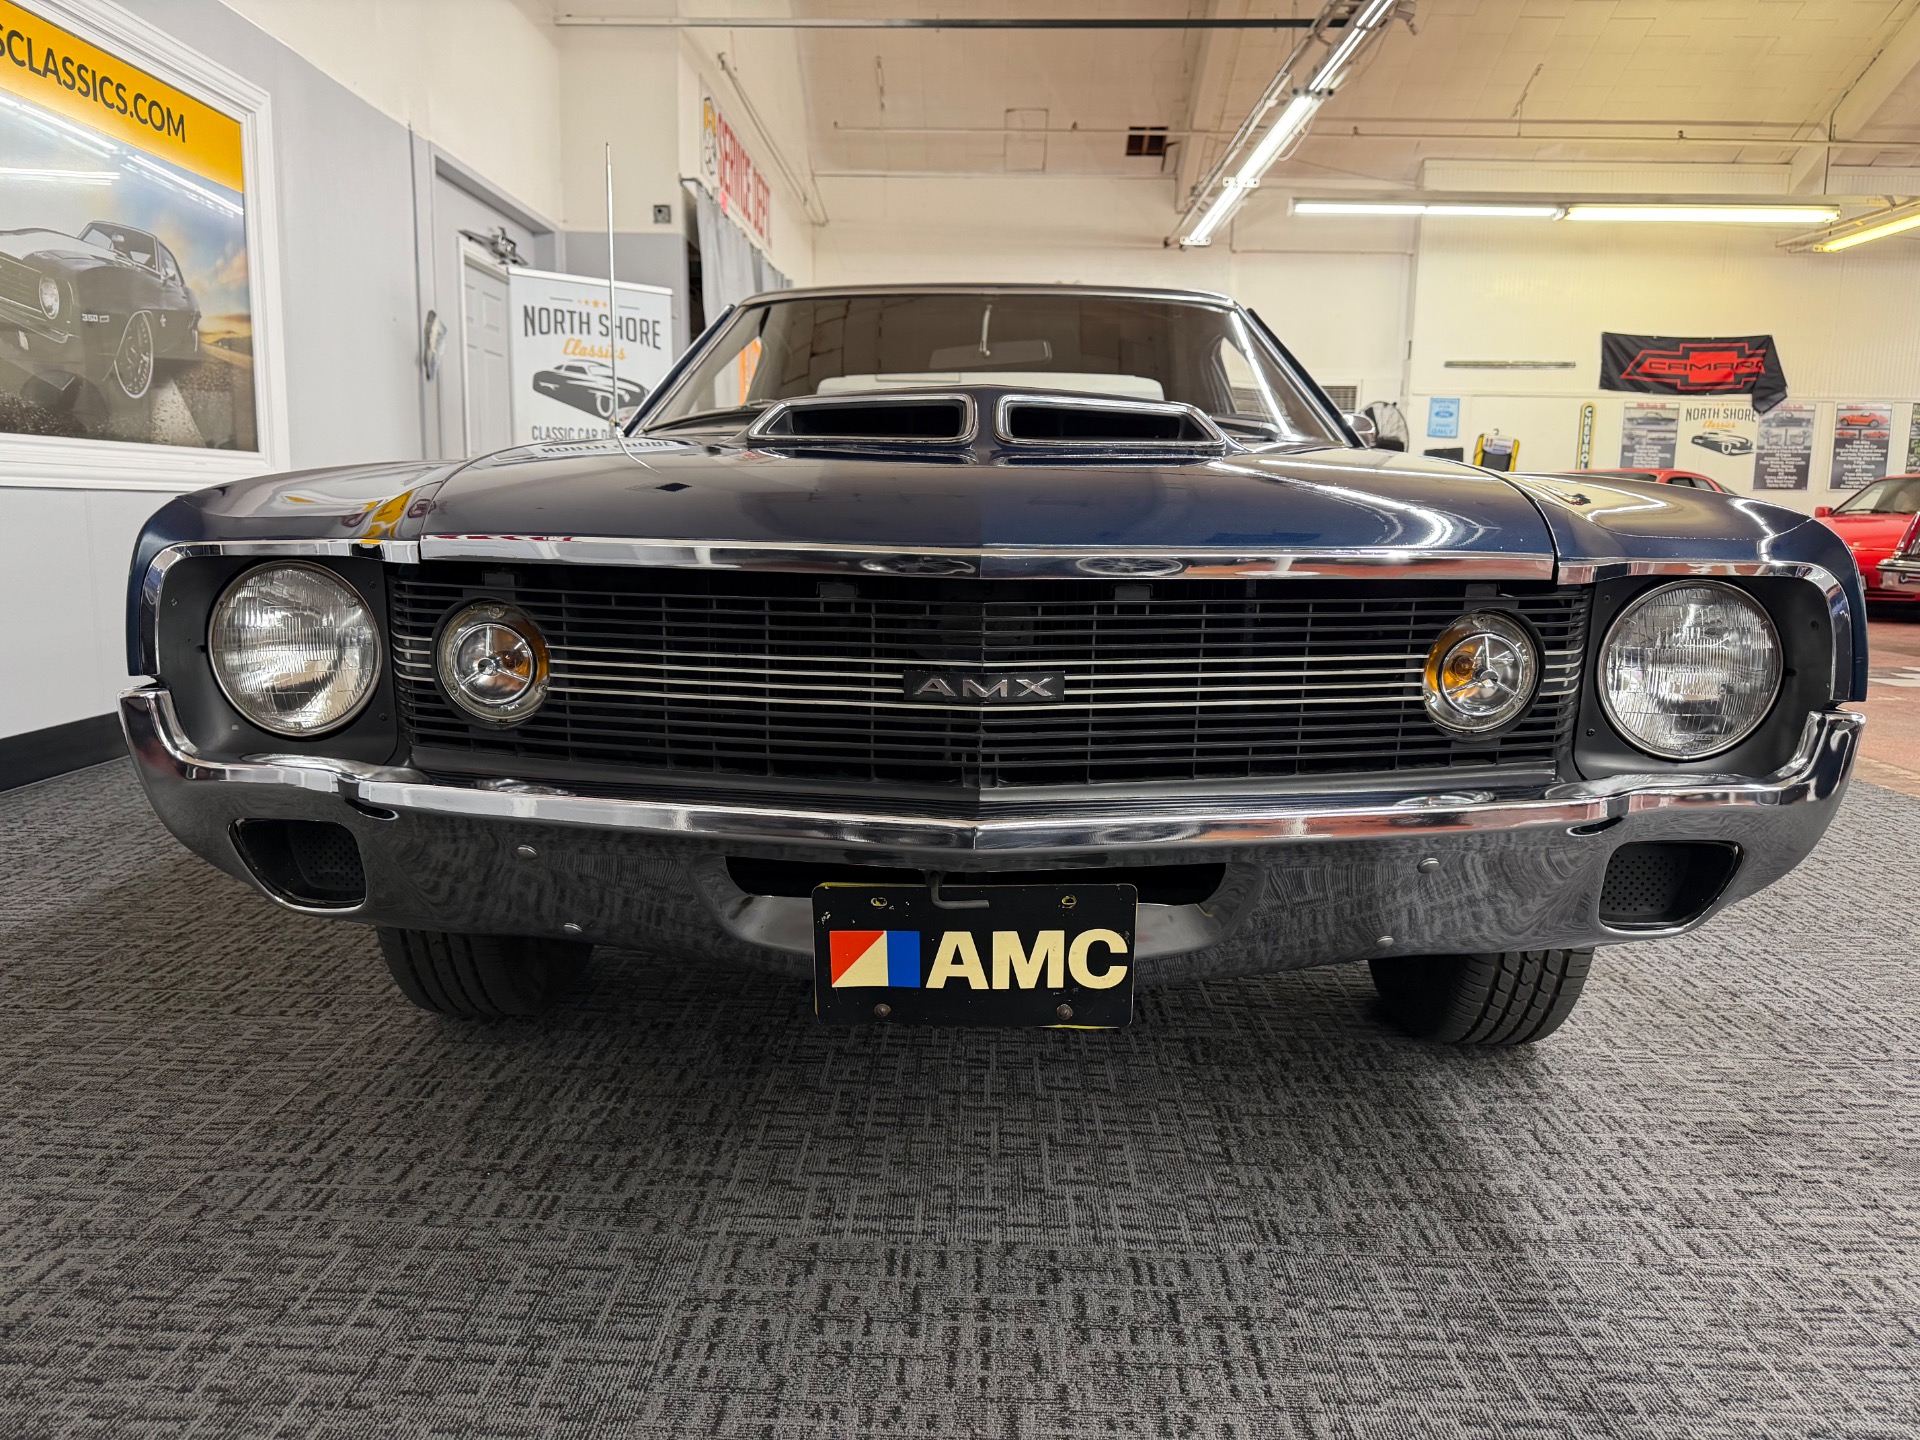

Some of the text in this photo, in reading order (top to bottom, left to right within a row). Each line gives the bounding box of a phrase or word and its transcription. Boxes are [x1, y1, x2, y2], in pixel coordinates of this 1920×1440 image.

[523, 304, 662, 350] NORTH SHORE
[563, 337, 627, 361] Classis
[1685, 407, 1756, 423] NORTH SHORE
[532, 425, 574, 441] CLASSIC
[578, 427, 598, 440] CAR
[913, 676, 1055, 698] AMX
[925, 928, 1128, 989] AMC
